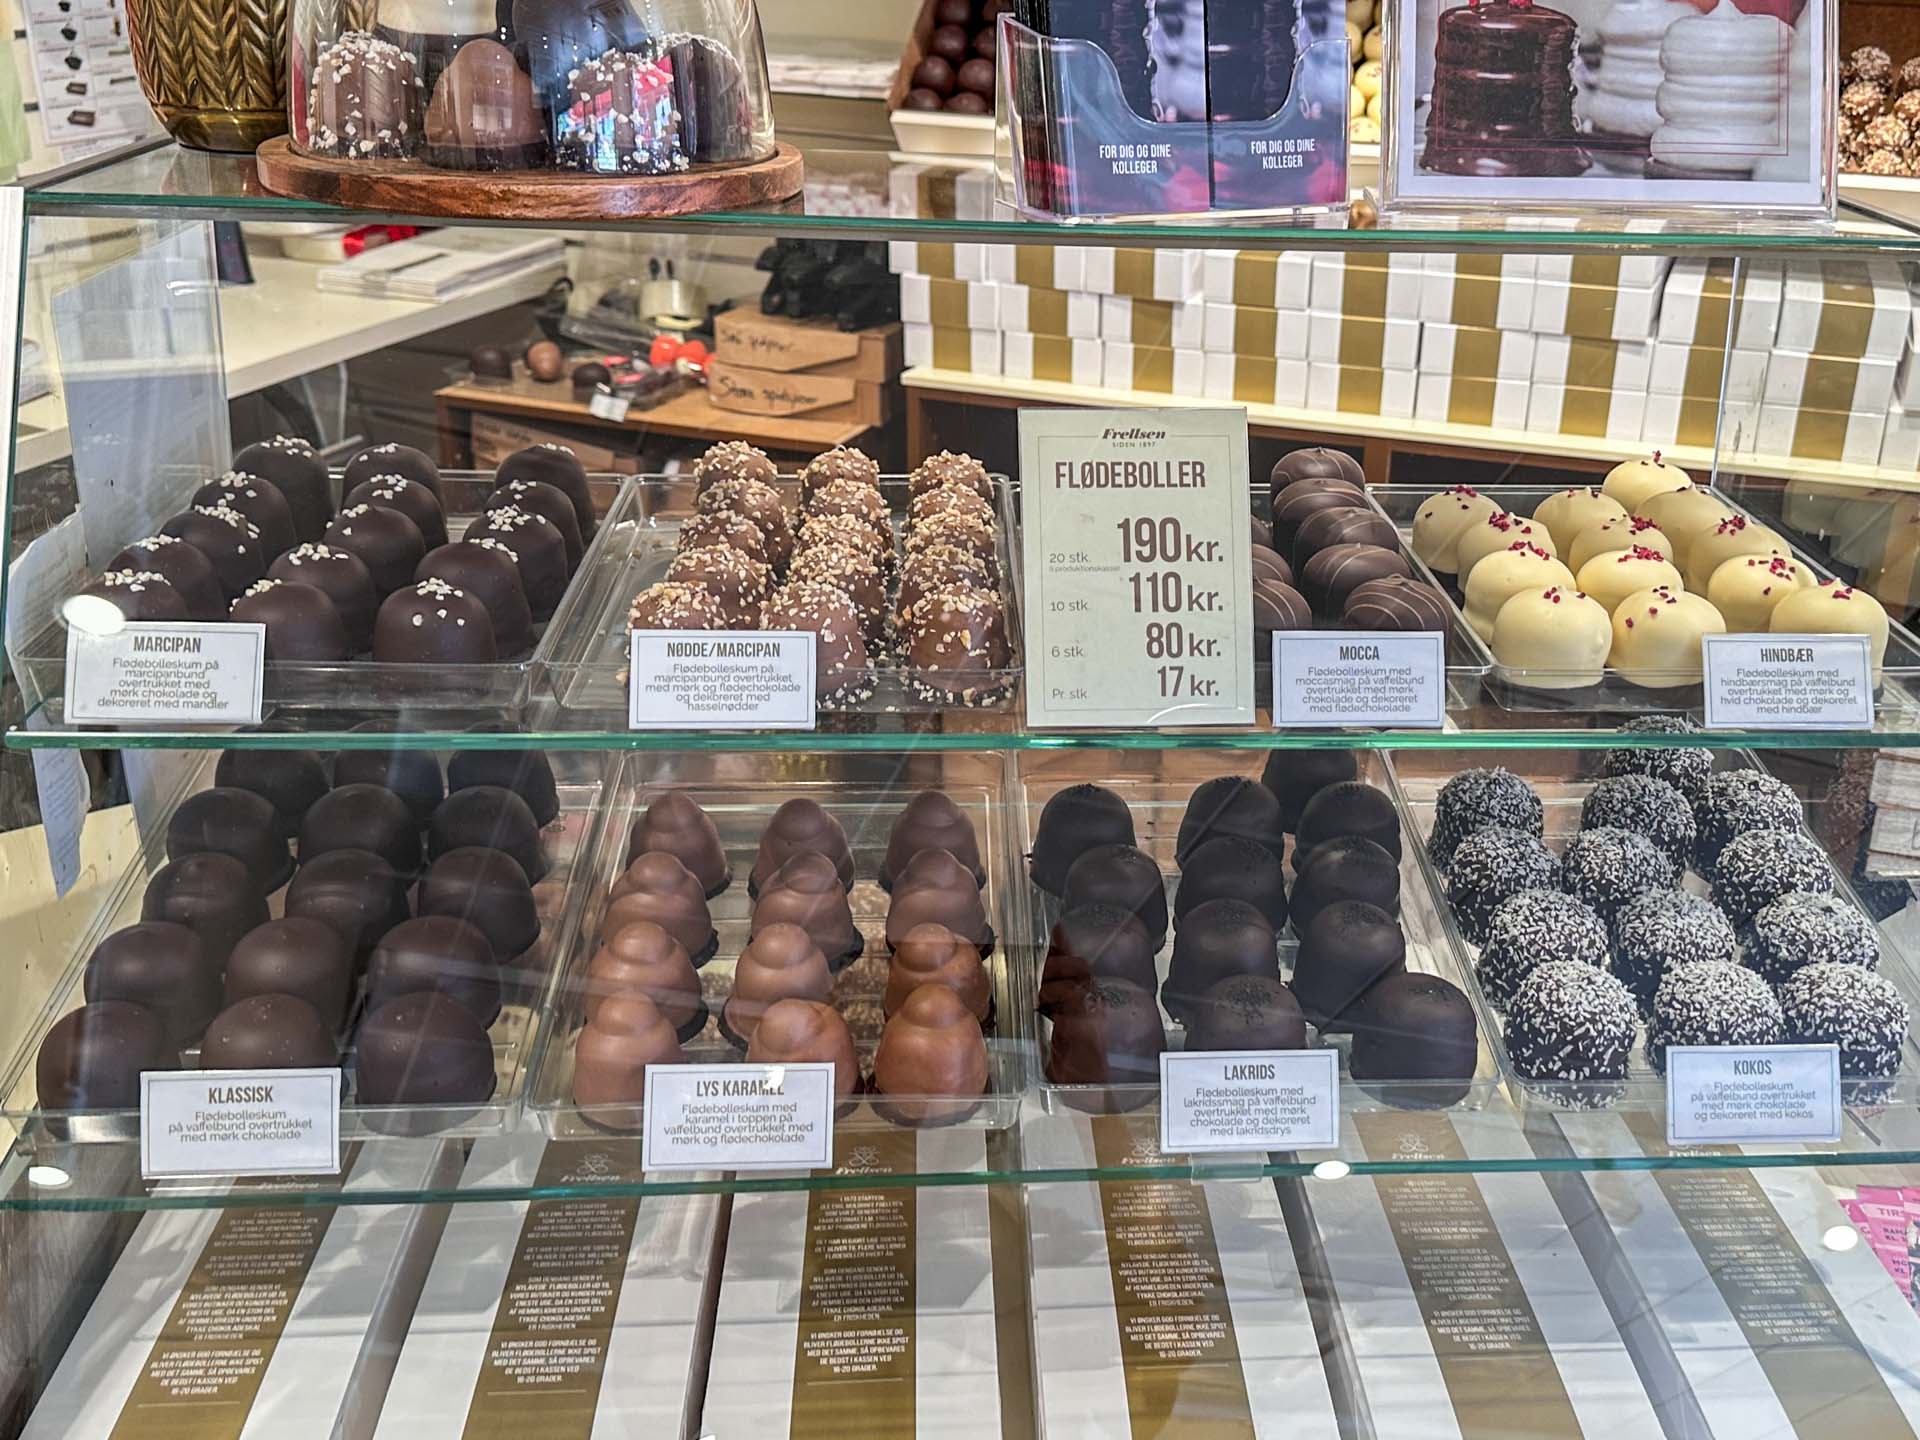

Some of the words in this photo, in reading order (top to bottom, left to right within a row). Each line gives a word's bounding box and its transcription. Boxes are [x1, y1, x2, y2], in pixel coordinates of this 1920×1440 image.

[1099, 145, 1117, 158] FOR
[1119, 145, 1134, 158] DIG
[1136, 145, 1148, 158] OG
[1150, 144, 1171, 157] DINE
[1251, 141, 1267, 154] FOR
[1269, 140, 1282, 153] DIG
[1284, 140, 1295, 153] OG
[1297, 139, 1315, 152] DINE
[1113, 161, 1157, 174] KOLLEGER
[1263, 155, 1303, 169] KOLLEGER
[1102, 428, 1165, 440] Frellsen
[1055, 460, 1205, 489] FLØDEBOLLER
[1050, 553, 1065, 563] 20
[1117, 517, 1181, 563] 190
[1186, 534, 1223, 562] kr.
[1051, 601, 1064, 611] 10
[1129, 572, 1182, 612] 110
[1187, 585, 1223, 611] kr.
[134, 636, 201, 653] MARCIPAN
[1052, 646, 1060, 658] 6
[1146, 622, 1183, 659] 80
[1189, 633, 1221, 656] kr.
[667, 642, 780, 657] NØDDE/MARCIPAN
[1340, 646, 1379, 661] MOCCA
[1761, 648, 1814, 662] HINDBÆR
[113, 658, 202, 669] Flødebolleskum
[205, 660, 219, 670] på
[673, 664, 758, 673] Flødebolleskum
[761, 663, 774, 674] på
[125, 669, 205, 679] marcipanbund
[1308, 667, 1387, 676] Flødebolleskum
[1389, 667, 1411, 675] med
[1737, 668, 1814, 678] Flødebolleskum
[1817, 669, 1839, 677] med
[119, 679, 181, 688] overtrukket
[184, 680, 210, 689] med
[654, 674, 730, 684] marcipanbund
[733, 674, 792, 682] overtrukket
[1157, 666, 1184, 697] 17
[1190, 674, 1219, 696] kr.
[1296, 677, 1356, 686] moccasmag
[1359, 676, 1370, 687] på
[1373, 676, 1424, 685] vaffelbund
[1721, 678, 1788, 687] hindbærsmag
[1790, 679, 1802, 688] på
[1805, 678, 1855, 686] vaffelbund
[110, 688, 138, 698] mørk
[142, 689, 199, 698] chokolade
[202, 691, 217, 700] og
[646, 683, 670, 692] med
[673, 683, 699, 692] mørk
[703, 684, 716, 694] og
[720, 683, 800, 693] flødechokolade
[1306, 686, 1361, 694] overtrukket
[1364, 686, 1386, 694] med
[1388, 686, 1413, 694] mørk
[1728, 687, 1782, 695] overtrukket
[1785, 687, 1807, 695] med
[1809, 687, 1835, 695] mørk
[1837, 689, 1848, 697] og
[98, 697, 150, 707] dekoreret
[154, 699, 179, 708] med
[183, 699, 228, 710] mandler
[676, 693, 690, 703] og
[693, 693, 743, 701] dekoreret
[746, 693, 770, 701] med
[1303, 695, 1353, 704] chokolade
[1356, 696, 1368, 705] og
[1371, 695, 1418, 703] dekoreret
[1721, 696, 1740, 704] hvid
[1743, 696, 1793, 705] chokolade
[1796, 698, 1808, 706] og
[1811, 696, 1857, 705] dekoreret
[688, 701, 759, 711] hasselnødder
[1310, 705, 1332, 713] med
[1335, 704, 1410, 713] flødechokolade
[1757, 705, 1779, 713] med
[1782, 705, 1823, 713] hindbær
[1224, 1064, 1275, 1080] LAKRIDS
[1734, 1060, 1772, 1075] KOKOS
[696, 1081, 719, 1097] LYS
[1196, 1087, 1278, 1098] Flødebolleskum
[1280, 1086, 1303, 1095] med
[1714, 1081, 1794, 1091] Flødebolleskum
[209, 1086, 273, 1104] KLASSISK
[1691, 1091, 1704, 1103] på
[1706, 1090, 1758, 1101] vaffelbund
[1761, 1090, 1816, 1100] overtrukket
[682, 1103, 770, 1113] Flødebolleskum
[772, 1102, 797, 1112] med
[1184, 1098, 1245, 1108] lakridssmag
[1248, 1097, 1260, 1107] på
[1263, 1096, 1316, 1106] vaffelbund
[1702, 1101, 1724, 1110] med
[1727, 1100, 1752, 1110] mørk
[1754, 1100, 1806, 1109] chokolade
[195, 1110, 286, 1121] Flødebolleskum
[1194, 1107, 1252, 1117] overtrukket
[1254, 1107, 1278, 1115] med
[1280, 1106, 1306, 1115] mørk
[1694, 1112, 1708, 1122] og
[1710, 1110, 1757, 1119] dekoreret
[1760, 1110, 1782, 1119] med
[1785, 1109, 1814, 1118] kokos
[685, 1113, 730, 1124] karamel
[737, 1113, 776, 1124] toppen
[779, 1113, 793, 1123] på
[1190, 1118, 1243, 1127] chokolade
[1246, 1118, 1259, 1127] og
[1262, 1115, 1310, 1125] dekoreret
[168, 1123, 183, 1134] på
[186, 1120, 245, 1131] vaffelbund
[249, 1118, 312, 1129] overtrukket
[664, 1124, 721, 1135] vaffelbund
[724, 1123, 786, 1134] overtrukket
[788, 1122, 814, 1132] med
[1210, 1127, 1233, 1136] med
[1236, 1126, 1292, 1137] lakridsdrys
[181, 1133, 206, 1143] med
[209, 1132, 239, 1141] mørk
[242, 1130, 301, 1141] chokolade
[672, 1135, 700, 1144] mørk
[703, 1136, 717, 1146] og
[721, 1133, 805, 1144] flødechokolade
